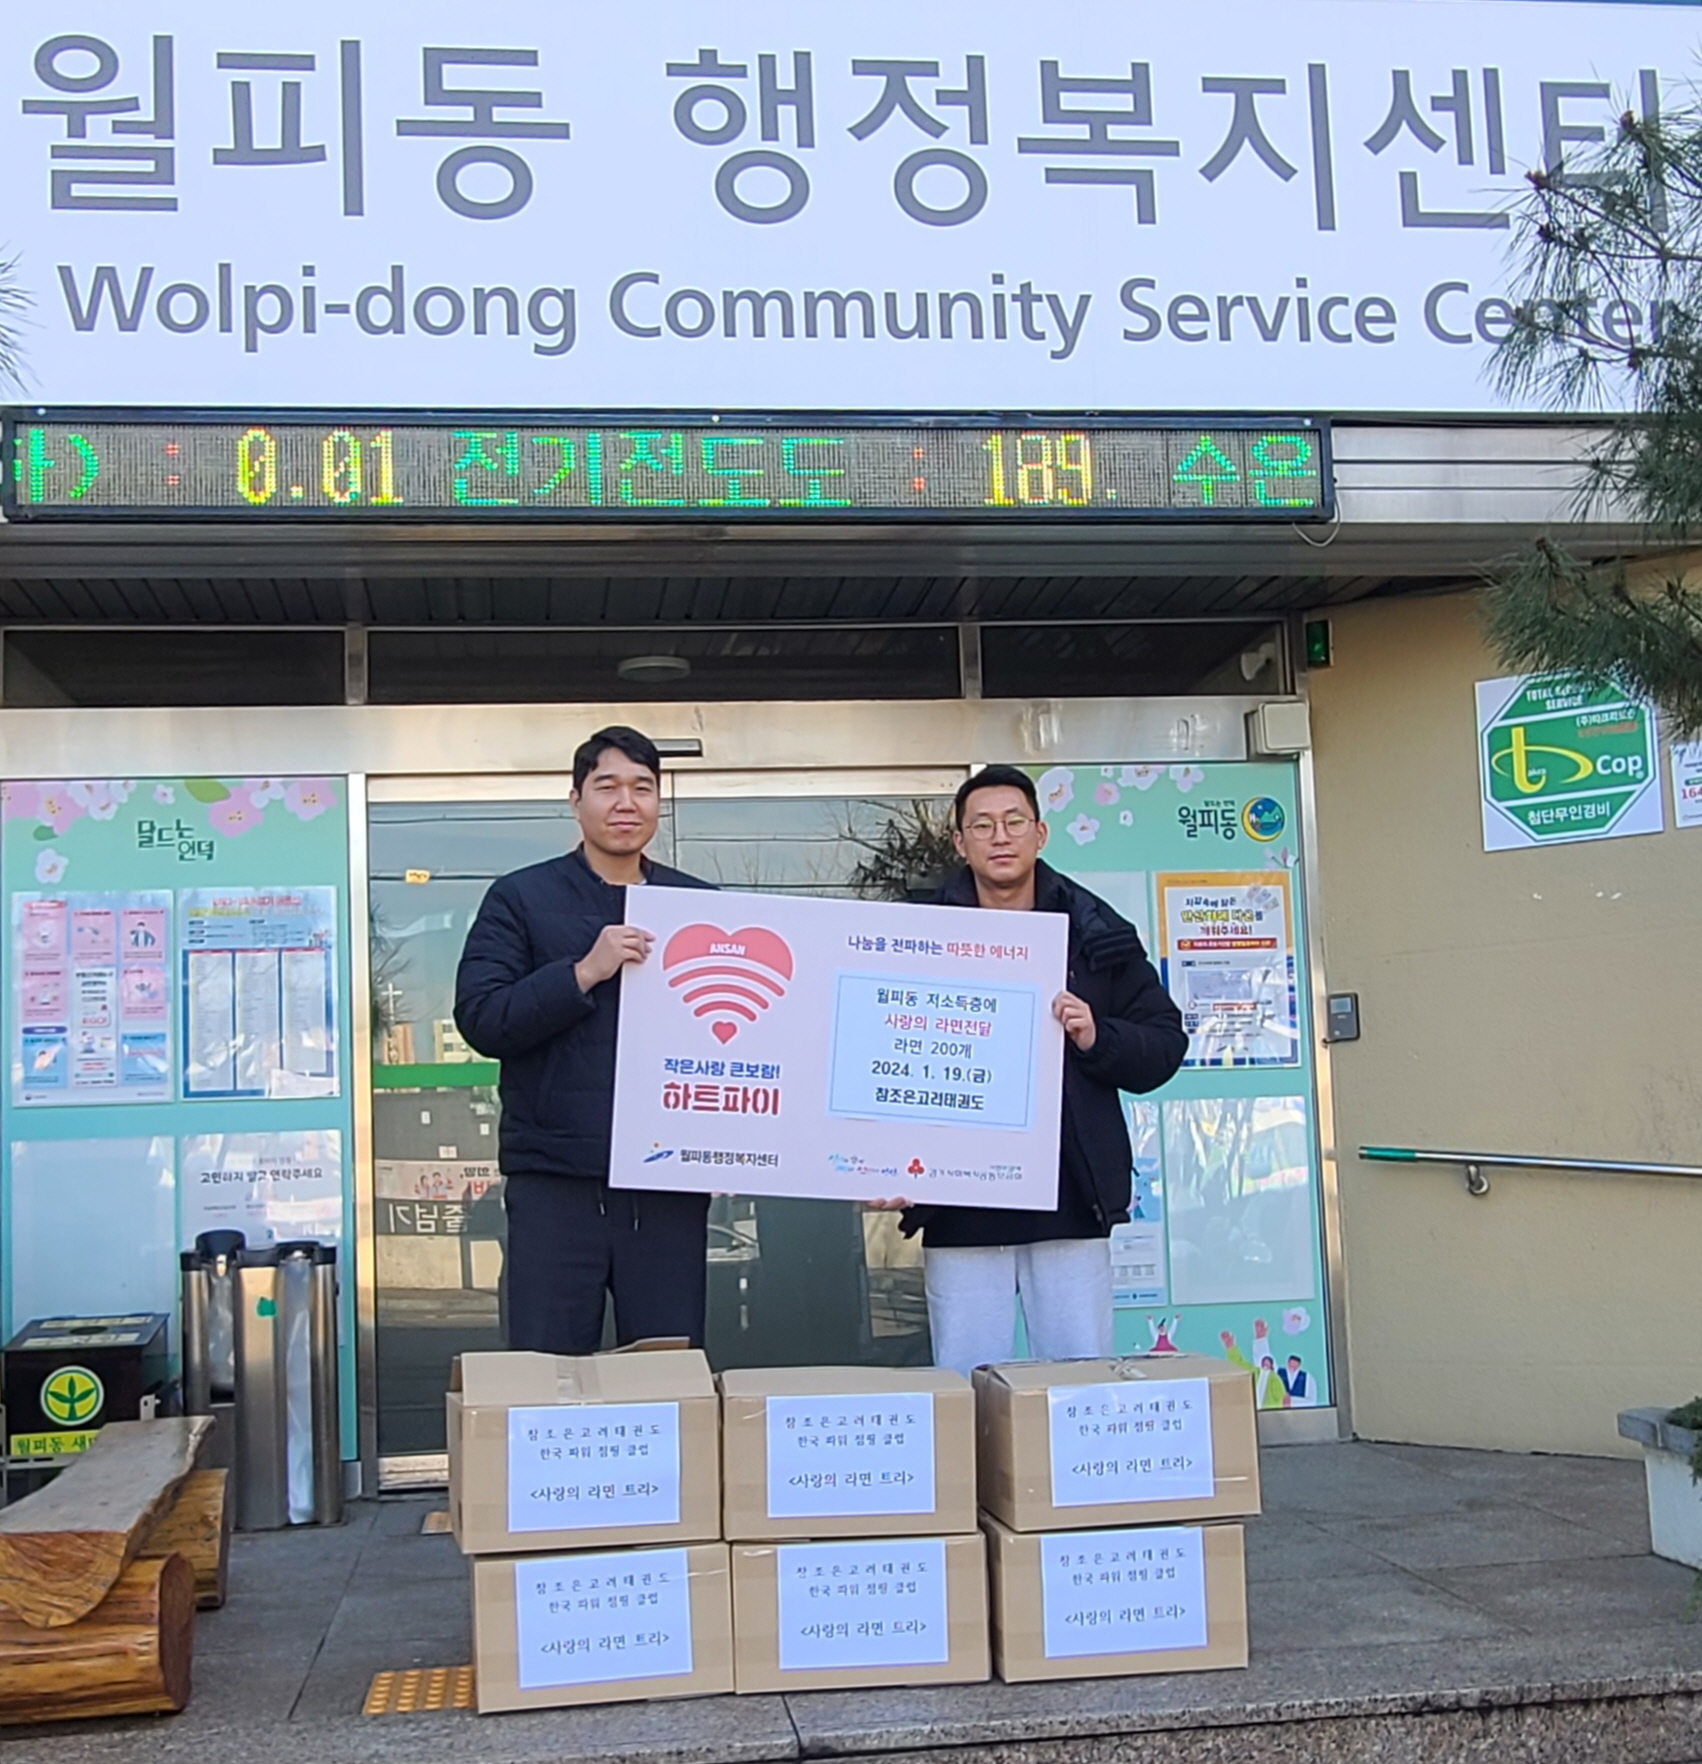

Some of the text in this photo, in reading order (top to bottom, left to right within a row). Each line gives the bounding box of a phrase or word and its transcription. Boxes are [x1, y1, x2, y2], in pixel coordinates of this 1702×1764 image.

[22, 34, 1669, 233] 월피동 행정복지센터
[58, 262, 577, 356] Wolpi-dong
[609, 271, 1092, 361] Community
[1119, 277, 1397, 344] Service
[237, 428, 403, 504] 0.01
[452, 431, 852, 506] 전기전도도
[1173, 434, 1317, 505] 수은
[1596, 755, 1643, 776] Cop
[1178, 806, 1238, 840] 월피동
[1527, 801, 1611, 825] 첨단무인경비
[138, 818, 194, 848] 달드는
[178, 840, 214, 861] 언덕
[710, 943, 746, 956] ANSAN
[848, 935, 1029, 960] 나눔을 전파하는 따뜻한 에너지
[877, 988, 997, 1013] 월피동 저소득층에
[884, 1013, 991, 1037] 사랑의 라면전달
[894, 1038, 972, 1059] 라면 200개
[664, 1058, 780, 1079] 작은사랑 큰보람!
[871, 1060, 914, 1077] 2024.
[923, 1065, 935, 1079] 1.
[663, 1082, 779, 1115] 하트파이
[875, 1087, 985, 1110] 참조은고려태권도
[680, 1149, 779, 1167] 월피동행정복지센터
[200, 1171, 243, 1184] 고민하지
[269, 1167, 323, 1181] 연락주세요
[1079, 1424, 1100, 1436] 한국
[16, 1436, 65, 1453] 월피동
[798, 1435, 819, 1448] 한국
[540, 1448, 562, 1460] 한국
[1072, 1455, 1193, 1476] <사랑의 라면 트리>
[789, 1471, 914, 1488] <사랑의 라면 트리>
[530, 1482, 659, 1502] <사랑의 라면 트리>
[1072, 1573, 1094, 1586] 한국
[809, 1585, 830, 1598] 한국
[549, 1600, 570, 1613] 한국
[1065, 1604, 1186, 1626] <사랑의 라면 트리>
[800, 1619, 927, 1638] <사랑의 라면 트리>
[541, 1631, 670, 1655] <사랑의 라면 트리>
